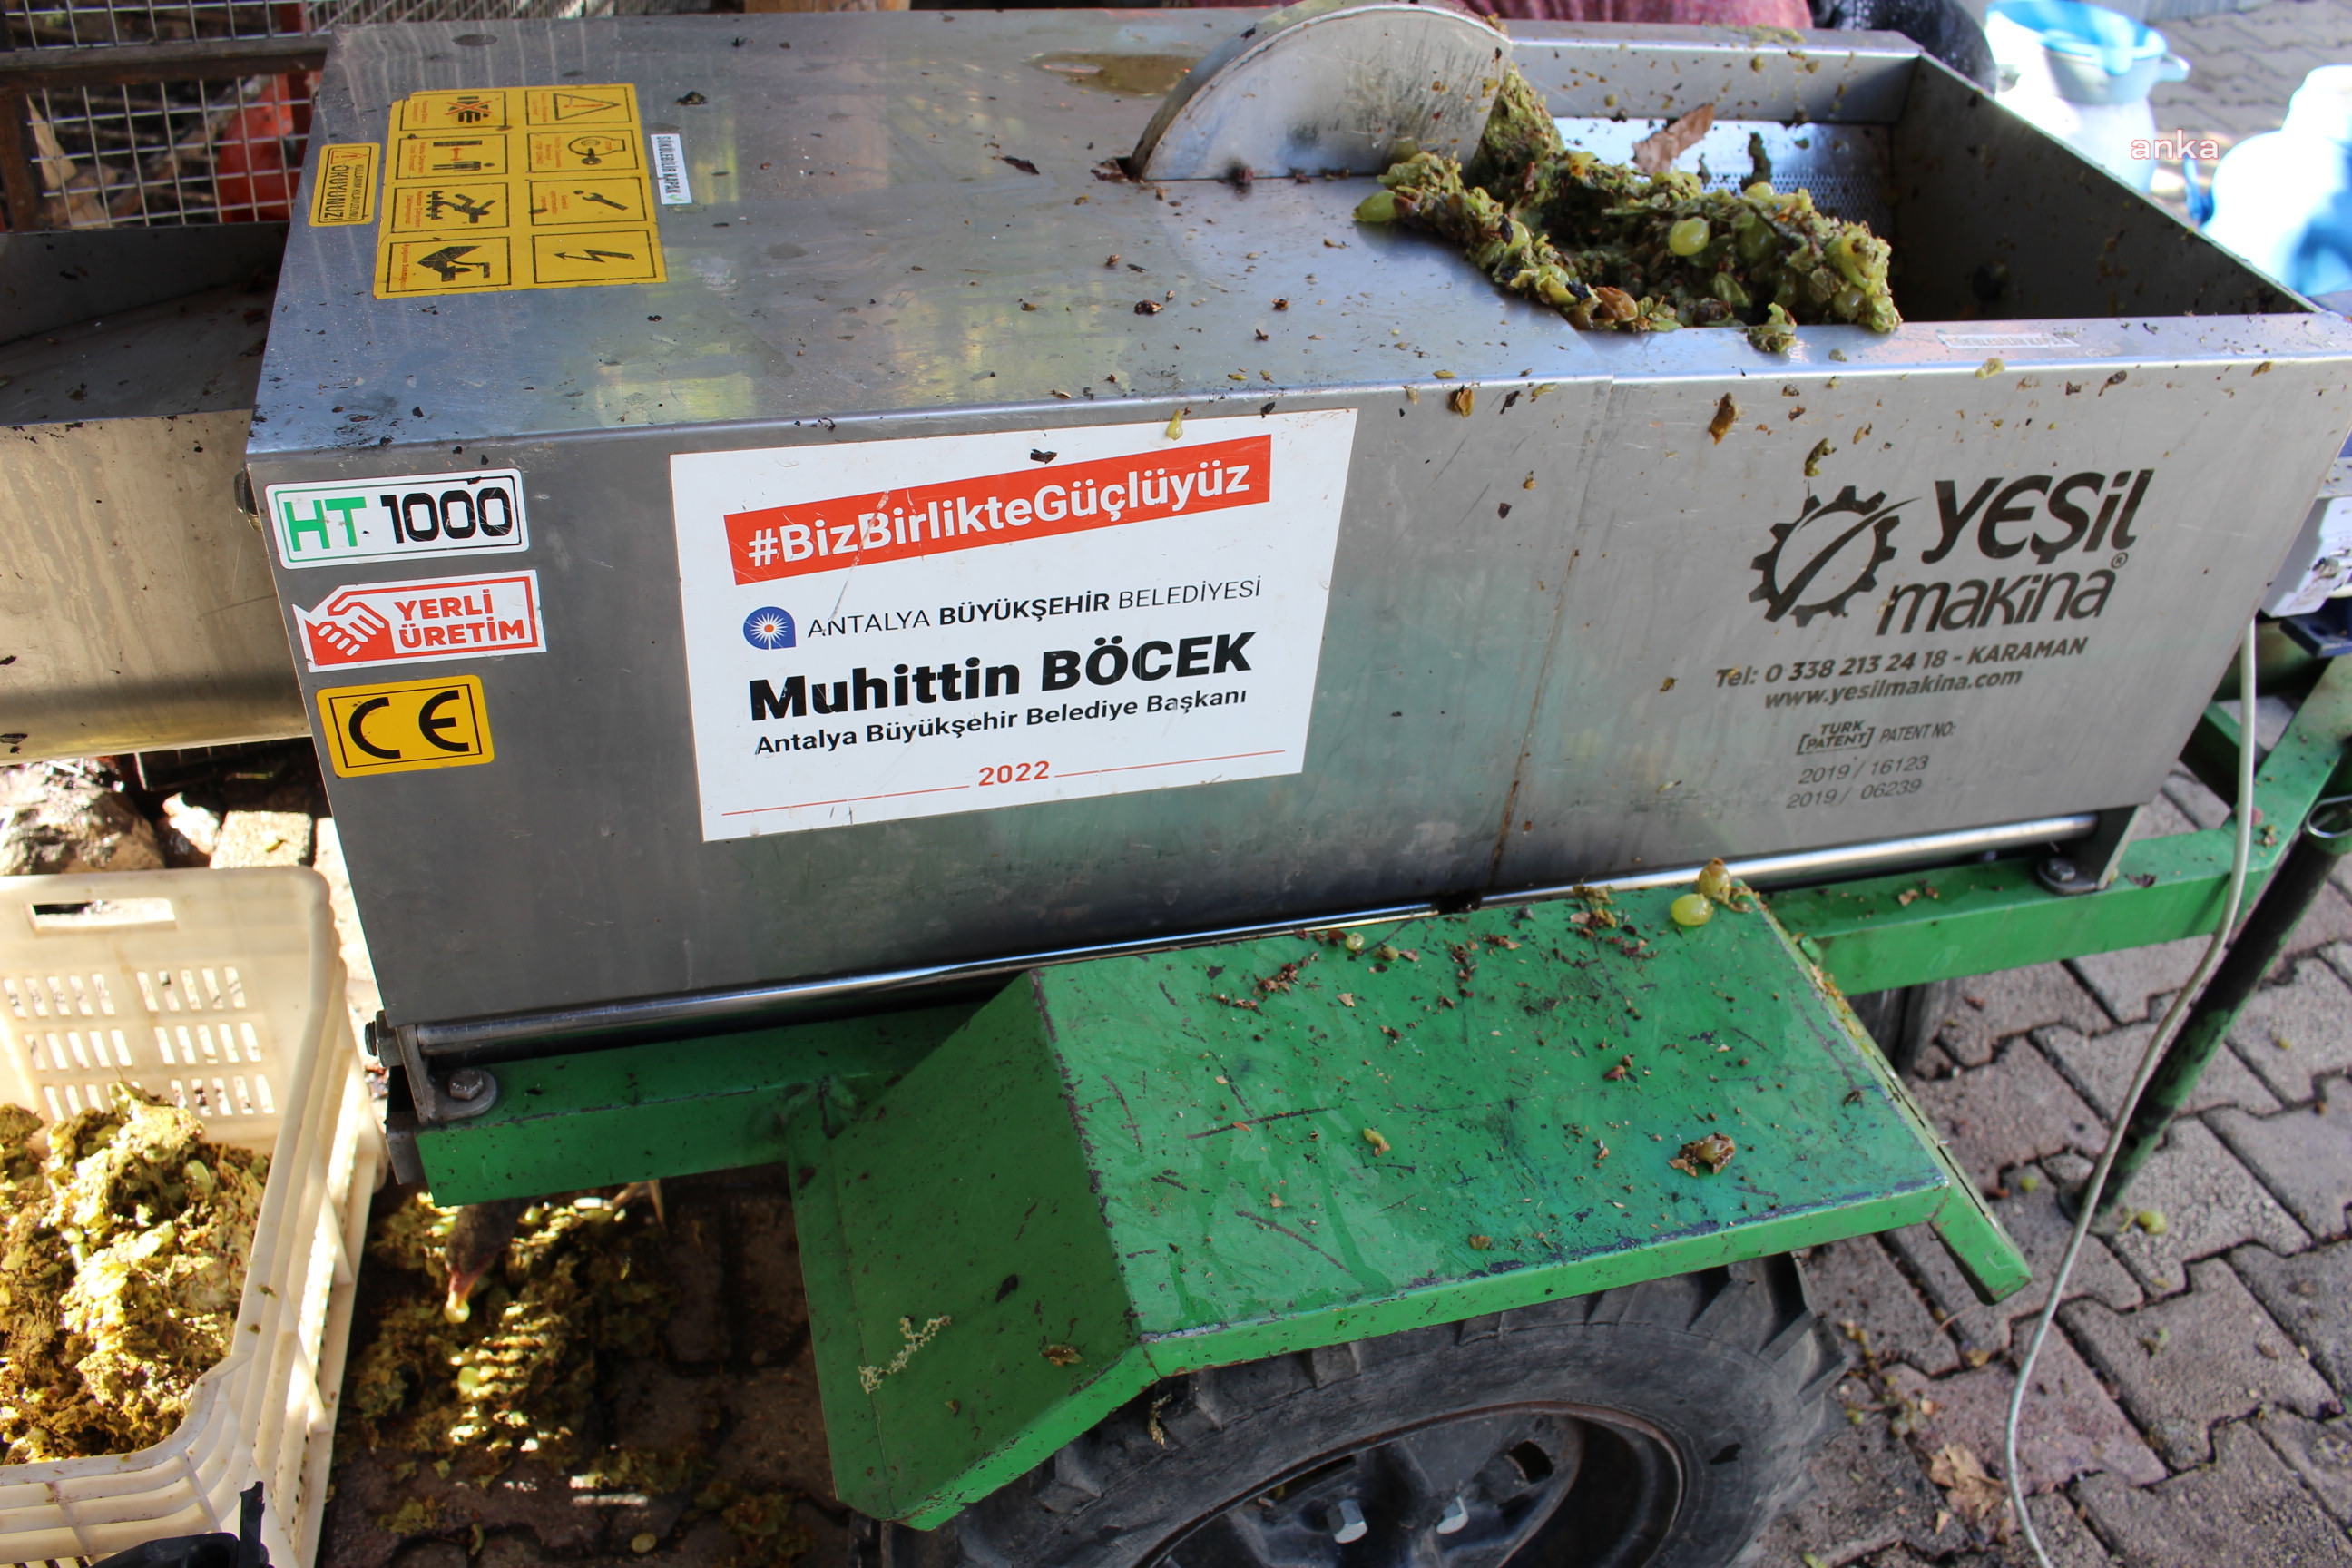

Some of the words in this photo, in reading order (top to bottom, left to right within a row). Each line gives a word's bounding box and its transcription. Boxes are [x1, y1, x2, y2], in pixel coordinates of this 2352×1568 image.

[323, 165, 349, 221] OKUYUNUZ!
[663, 173, 681, 193] KAPAK
[283, 496, 368, 553] HT
[380, 486, 514, 544] 1000
[747, 460, 1250, 567] #BizBirlikteGüçlüyüz
[394, 589, 493, 622] YERLİ
[807, 608, 931, 639] ANTALYA
[938, 590, 1111, 627] BÜYÜKŞEHİR
[1117, 575, 1262, 612] BELEDİYESİ
[398, 616, 526, 649] ÜRETİM
[750, 656, 1020, 722] Muhittin
[1041, 631, 1259, 692] BÖCEK
[1715, 667, 1760, 689] Tel:
[1788, 658, 1835, 681] 338
[1838, 654, 1883, 677] 213
[1884, 652, 1917, 674] 24
[1922, 649, 1949, 670] 18
[1965, 637, 2090, 666] KARAMAN
[1764, 669, 2024, 710] www.yesilmakina.com
[348, 690, 470, 760] CE
[754, 727, 858, 756] Antalya
[866, 708, 1018, 745] Büyükşehir
[1026, 696, 1139, 729] Belediye
[1146, 687, 1248, 717] Başkanı
[1879, 723, 1932, 745] PATENT
[977, 760, 1051, 789] 2022
[1798, 763, 1852, 786] 2019
[1870, 754, 1930, 776] 16123
[1785, 788, 1838, 810] 2019
[1860, 778, 1924, 800] 06239
